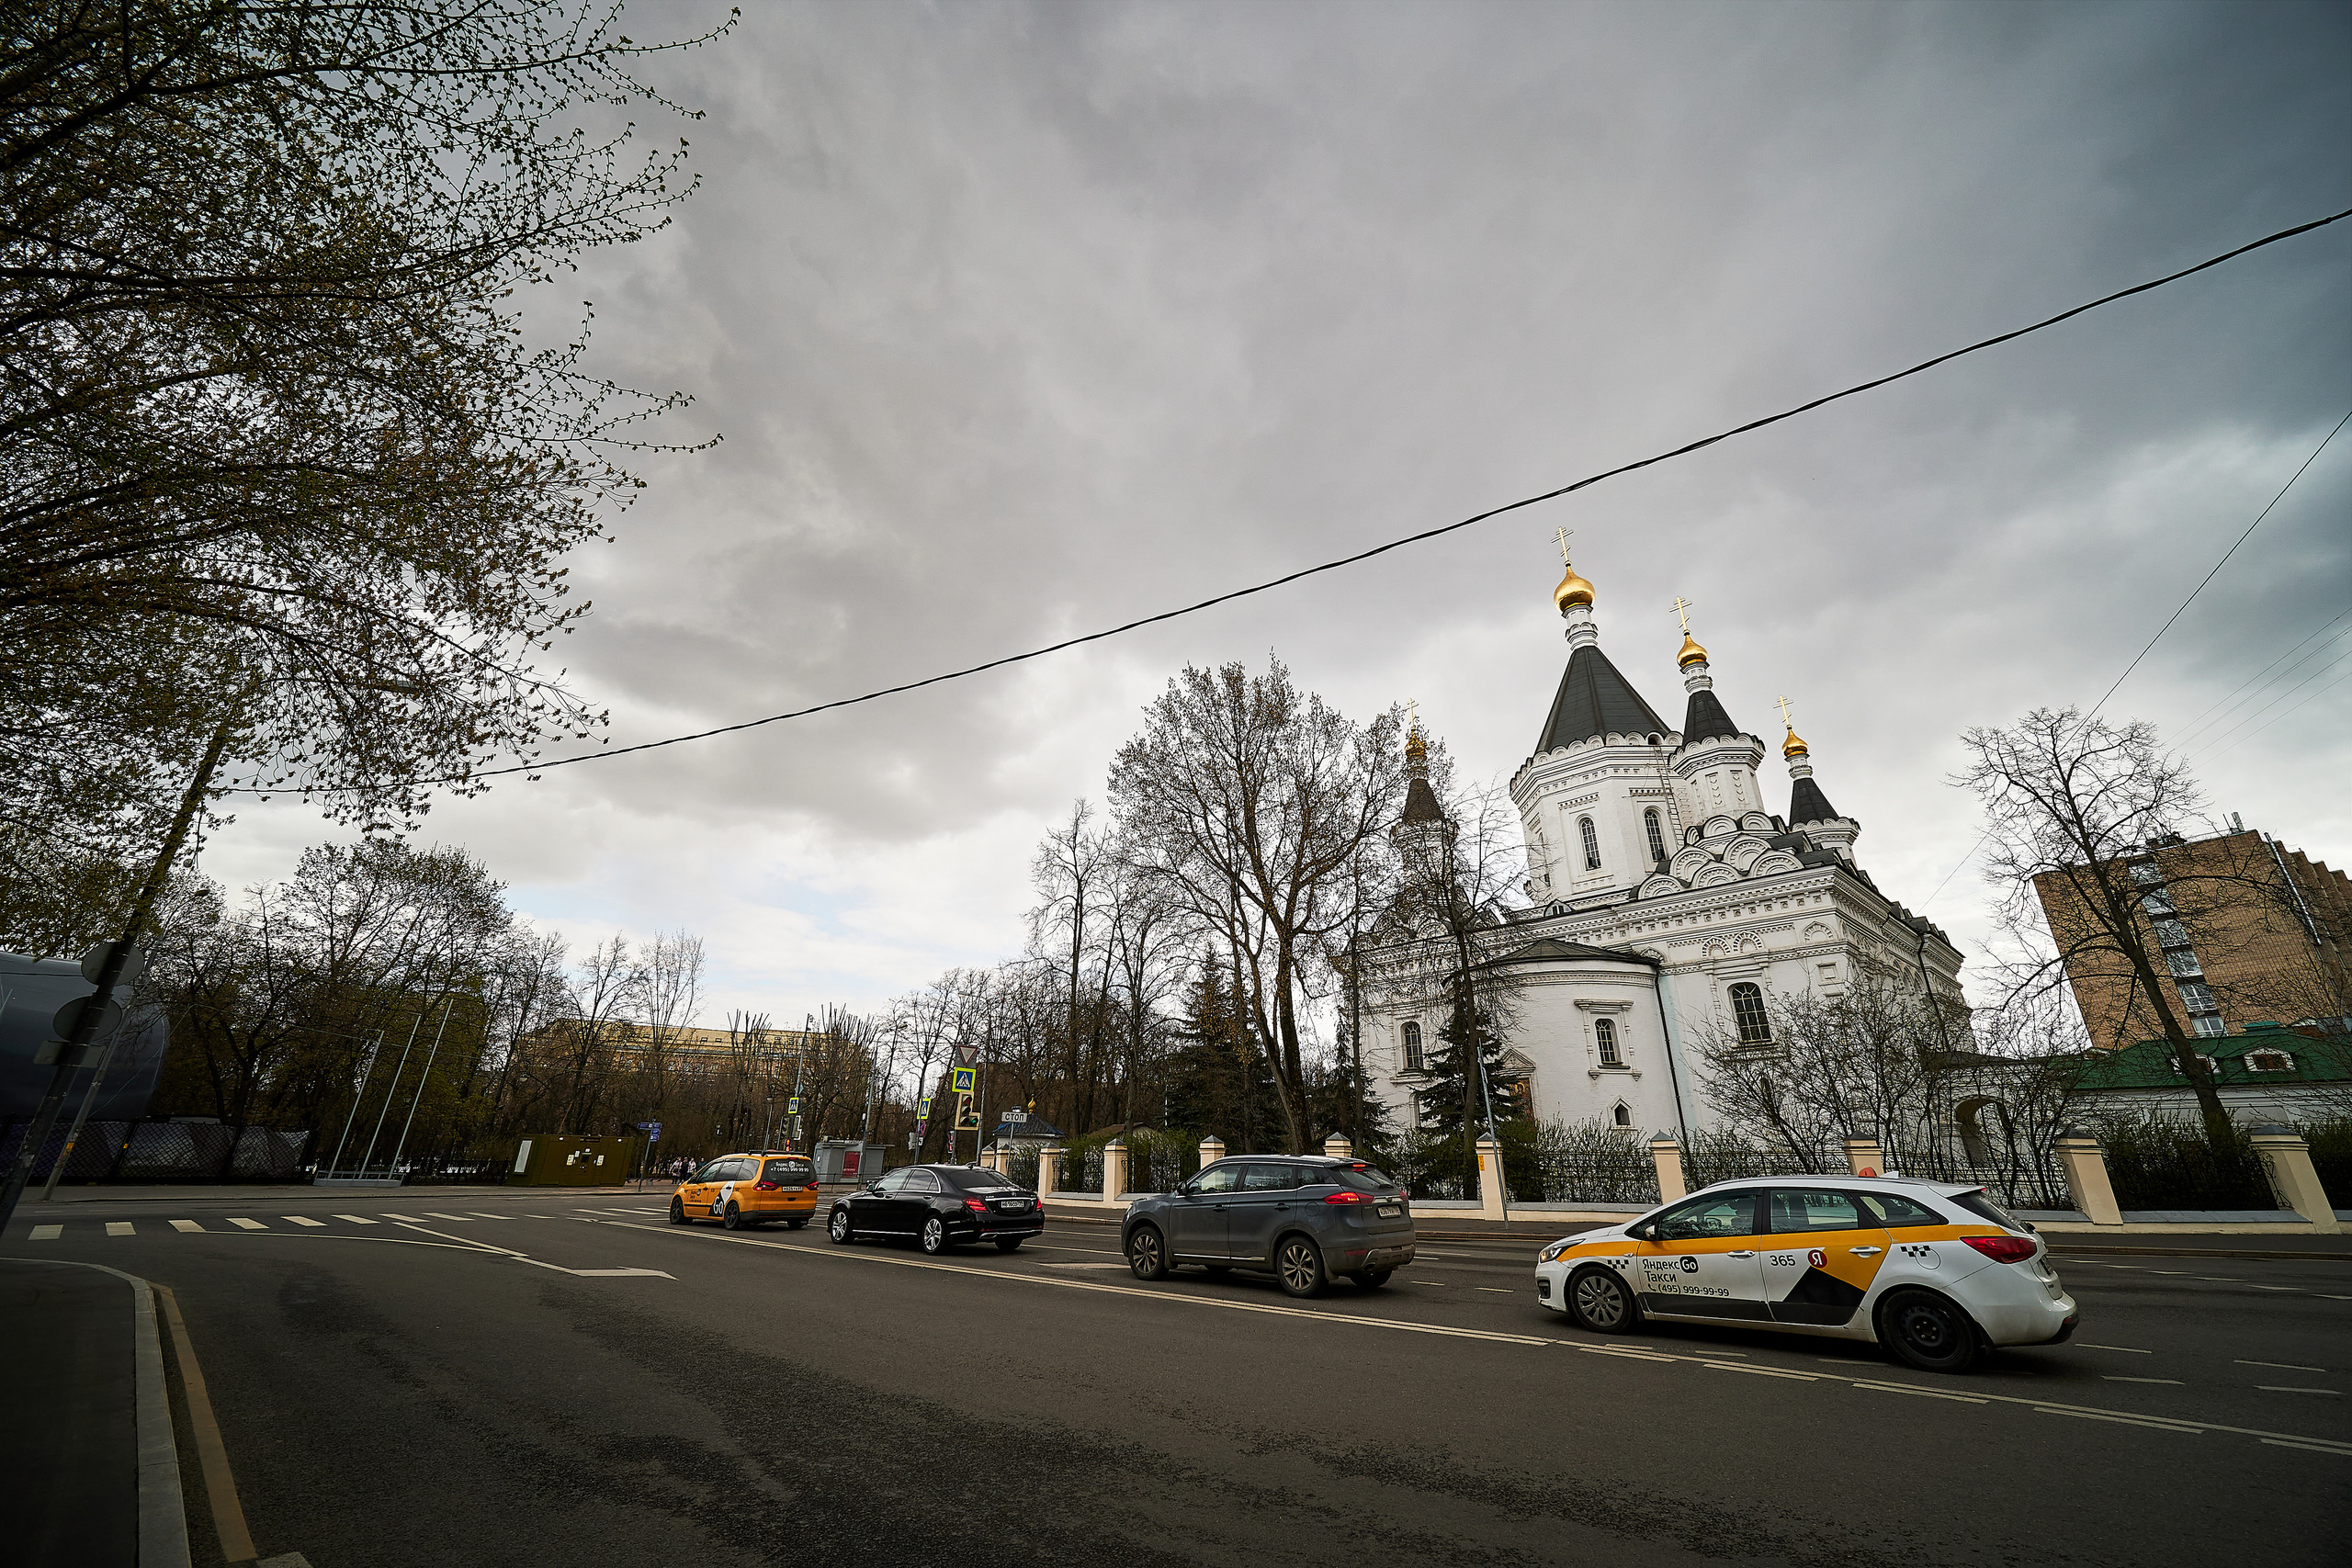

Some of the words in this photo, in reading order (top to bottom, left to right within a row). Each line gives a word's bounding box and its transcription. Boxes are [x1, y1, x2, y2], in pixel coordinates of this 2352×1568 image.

[1642, 1258, 1680, 1271] Яндекс
[1681, 1258, 1697, 1270] Go
[1770, 1255, 1796, 1266] 365
[1811, 1252, 1823, 1266] Я
[1645, 1270, 1677, 1282] Такси
[1657, 1283, 1681, 1294] (495)
[1683, 1285, 1730, 1297] 999-99-99
